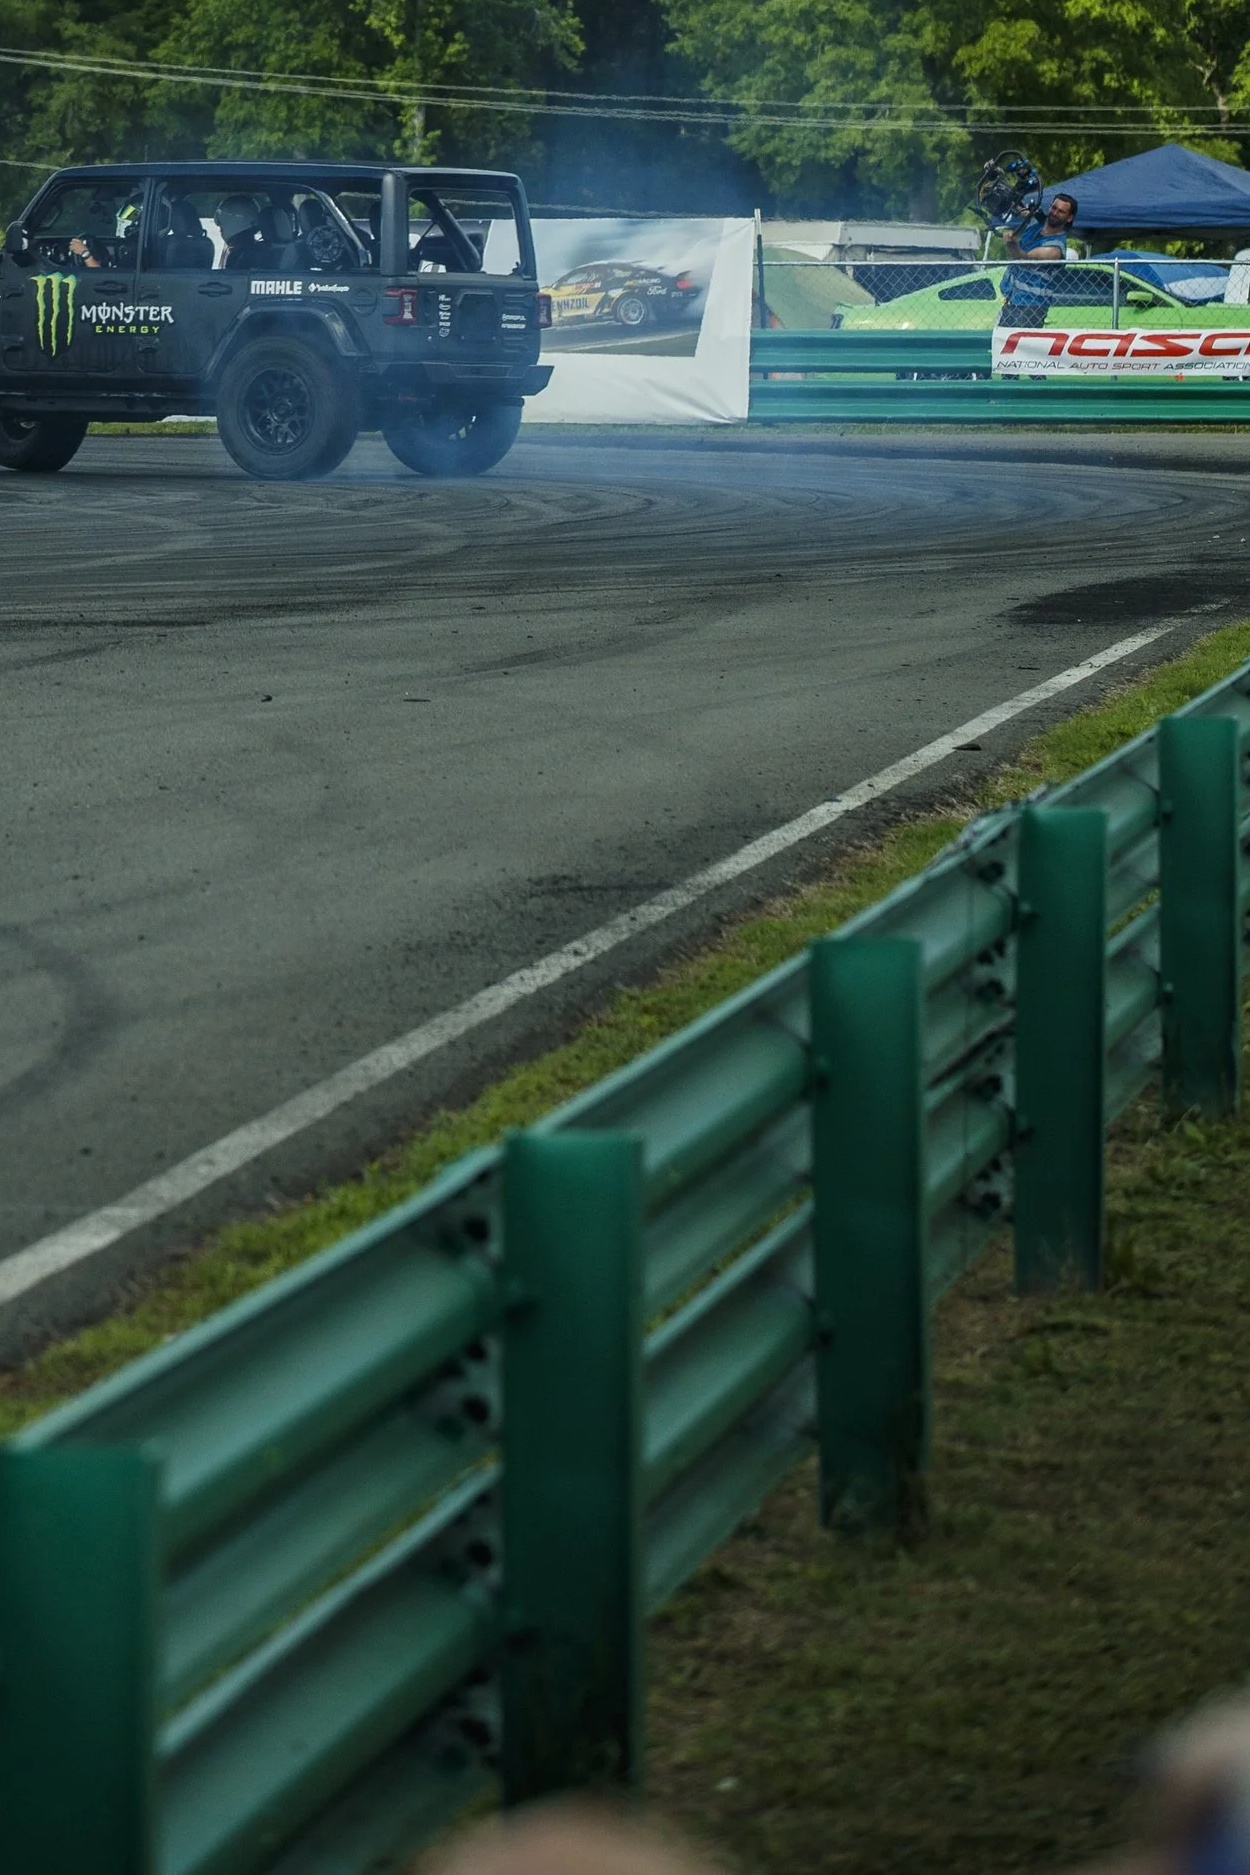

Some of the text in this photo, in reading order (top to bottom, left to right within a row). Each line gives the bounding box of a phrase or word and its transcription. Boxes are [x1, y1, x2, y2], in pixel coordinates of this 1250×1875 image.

[251, 280, 302, 294] MAHLE
[647, 285, 667, 296] Ford
[551, 297, 590, 312] ENNZOIL
[81, 302, 174, 324] MONSTER
[95, 326, 160, 334] ENERGY
[997, 360, 1065, 370] NATIONAL
[1069, 362, 1109, 371] AUTO
[1112, 362, 1161, 371] SPORT
